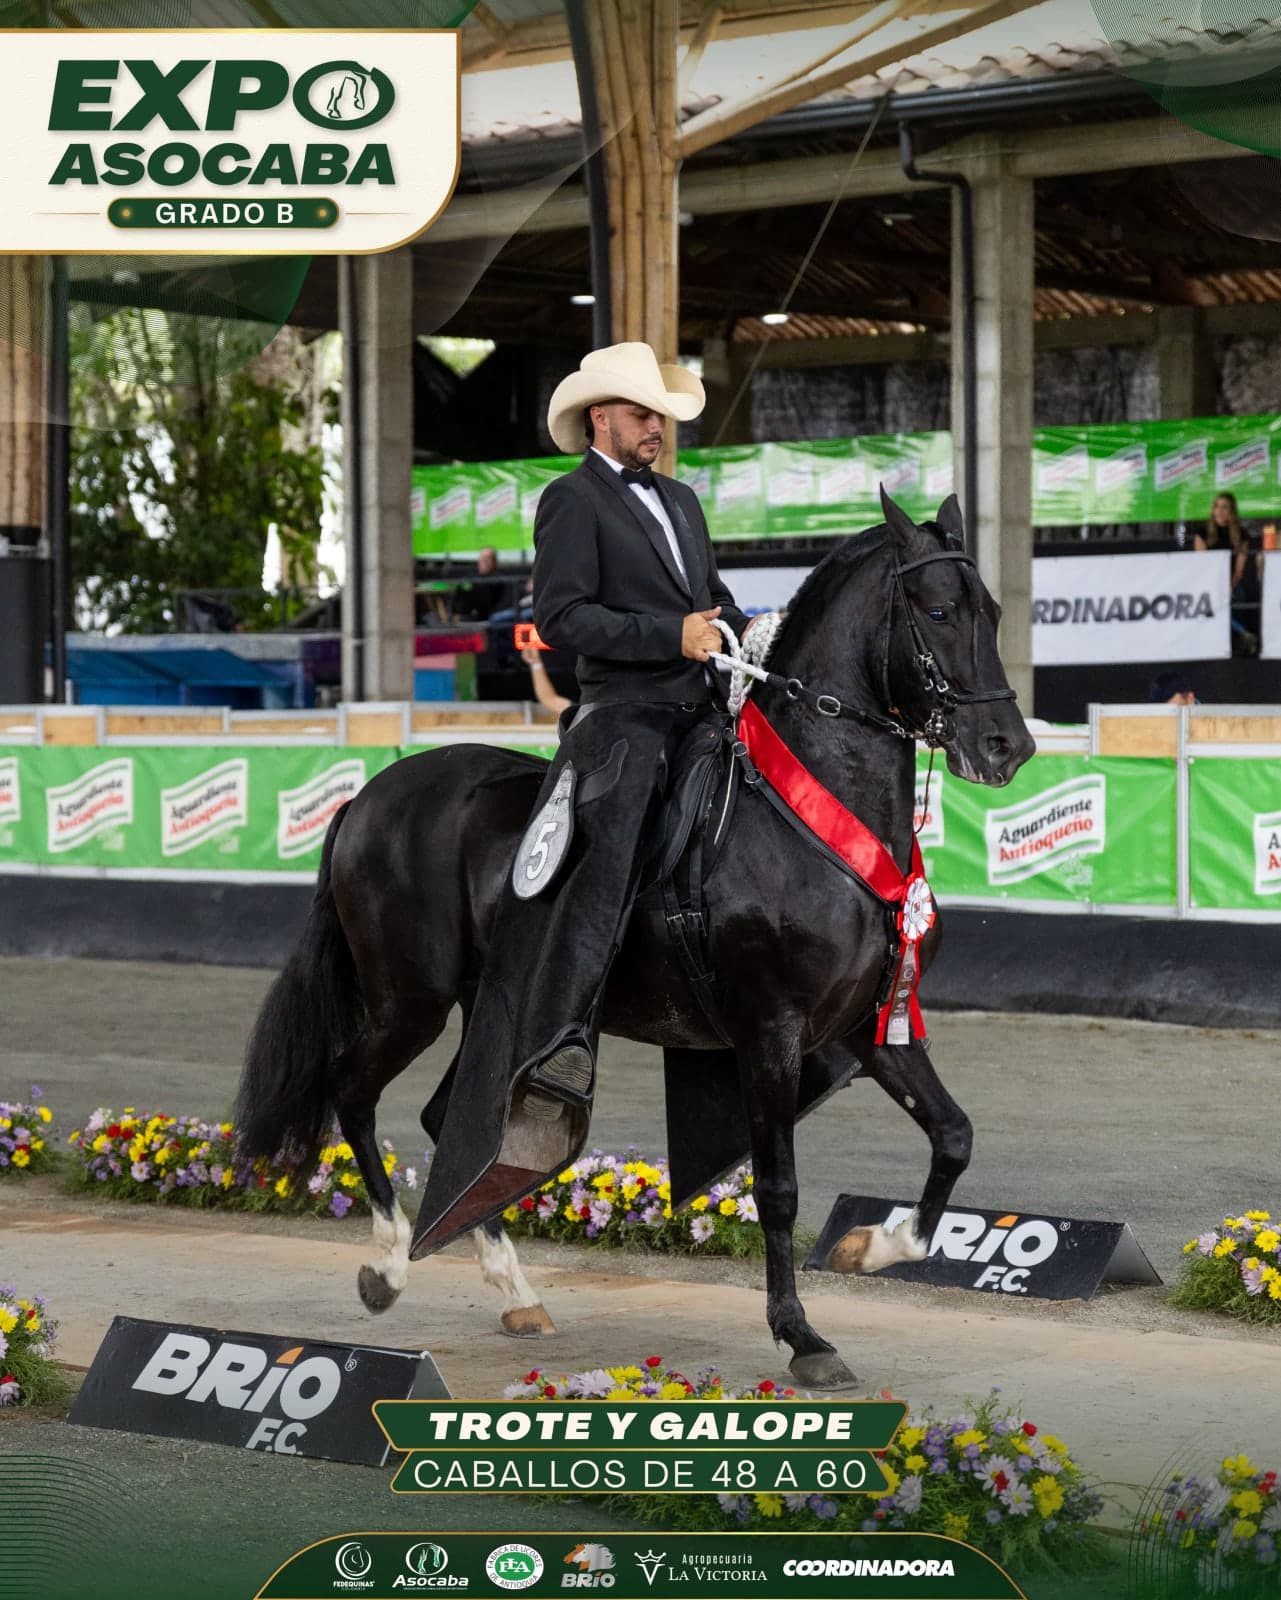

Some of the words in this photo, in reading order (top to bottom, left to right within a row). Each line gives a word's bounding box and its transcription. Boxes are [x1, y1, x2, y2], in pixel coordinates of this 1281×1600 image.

[1032, 593, 1214, 624] RDINADORA
[999, 799, 1093, 844] Aguardiente
[1000, 816, 1094, 862] Antioqueño
[526, 822, 558, 880] 5
[973, 1266, 1032, 1293] F.C.
[244, 1418, 308, 1455] F.C.
